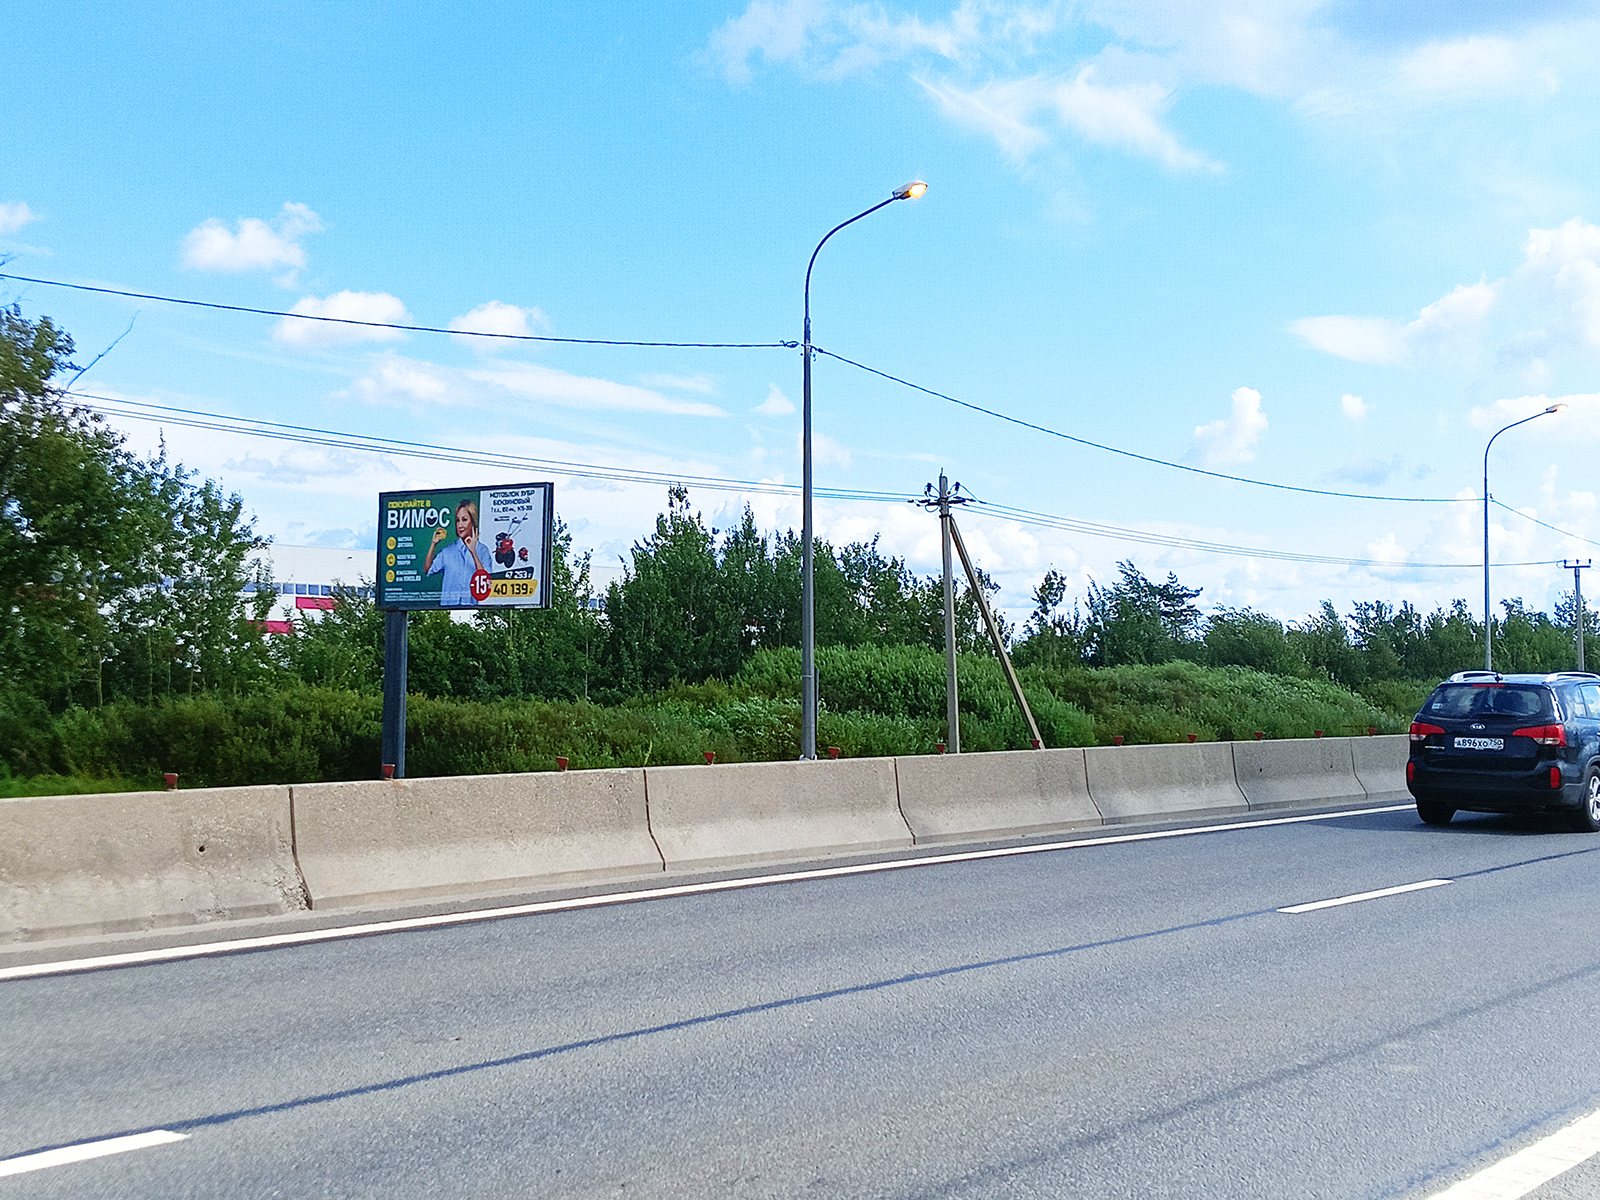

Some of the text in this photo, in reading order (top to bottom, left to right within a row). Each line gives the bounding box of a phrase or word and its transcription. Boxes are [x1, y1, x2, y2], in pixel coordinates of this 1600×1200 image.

[388, 499, 425, 508] ПОКУПАЙТЕ
[387, 508, 450, 528] ВИМОС
[493, 583, 507, 595] 40
